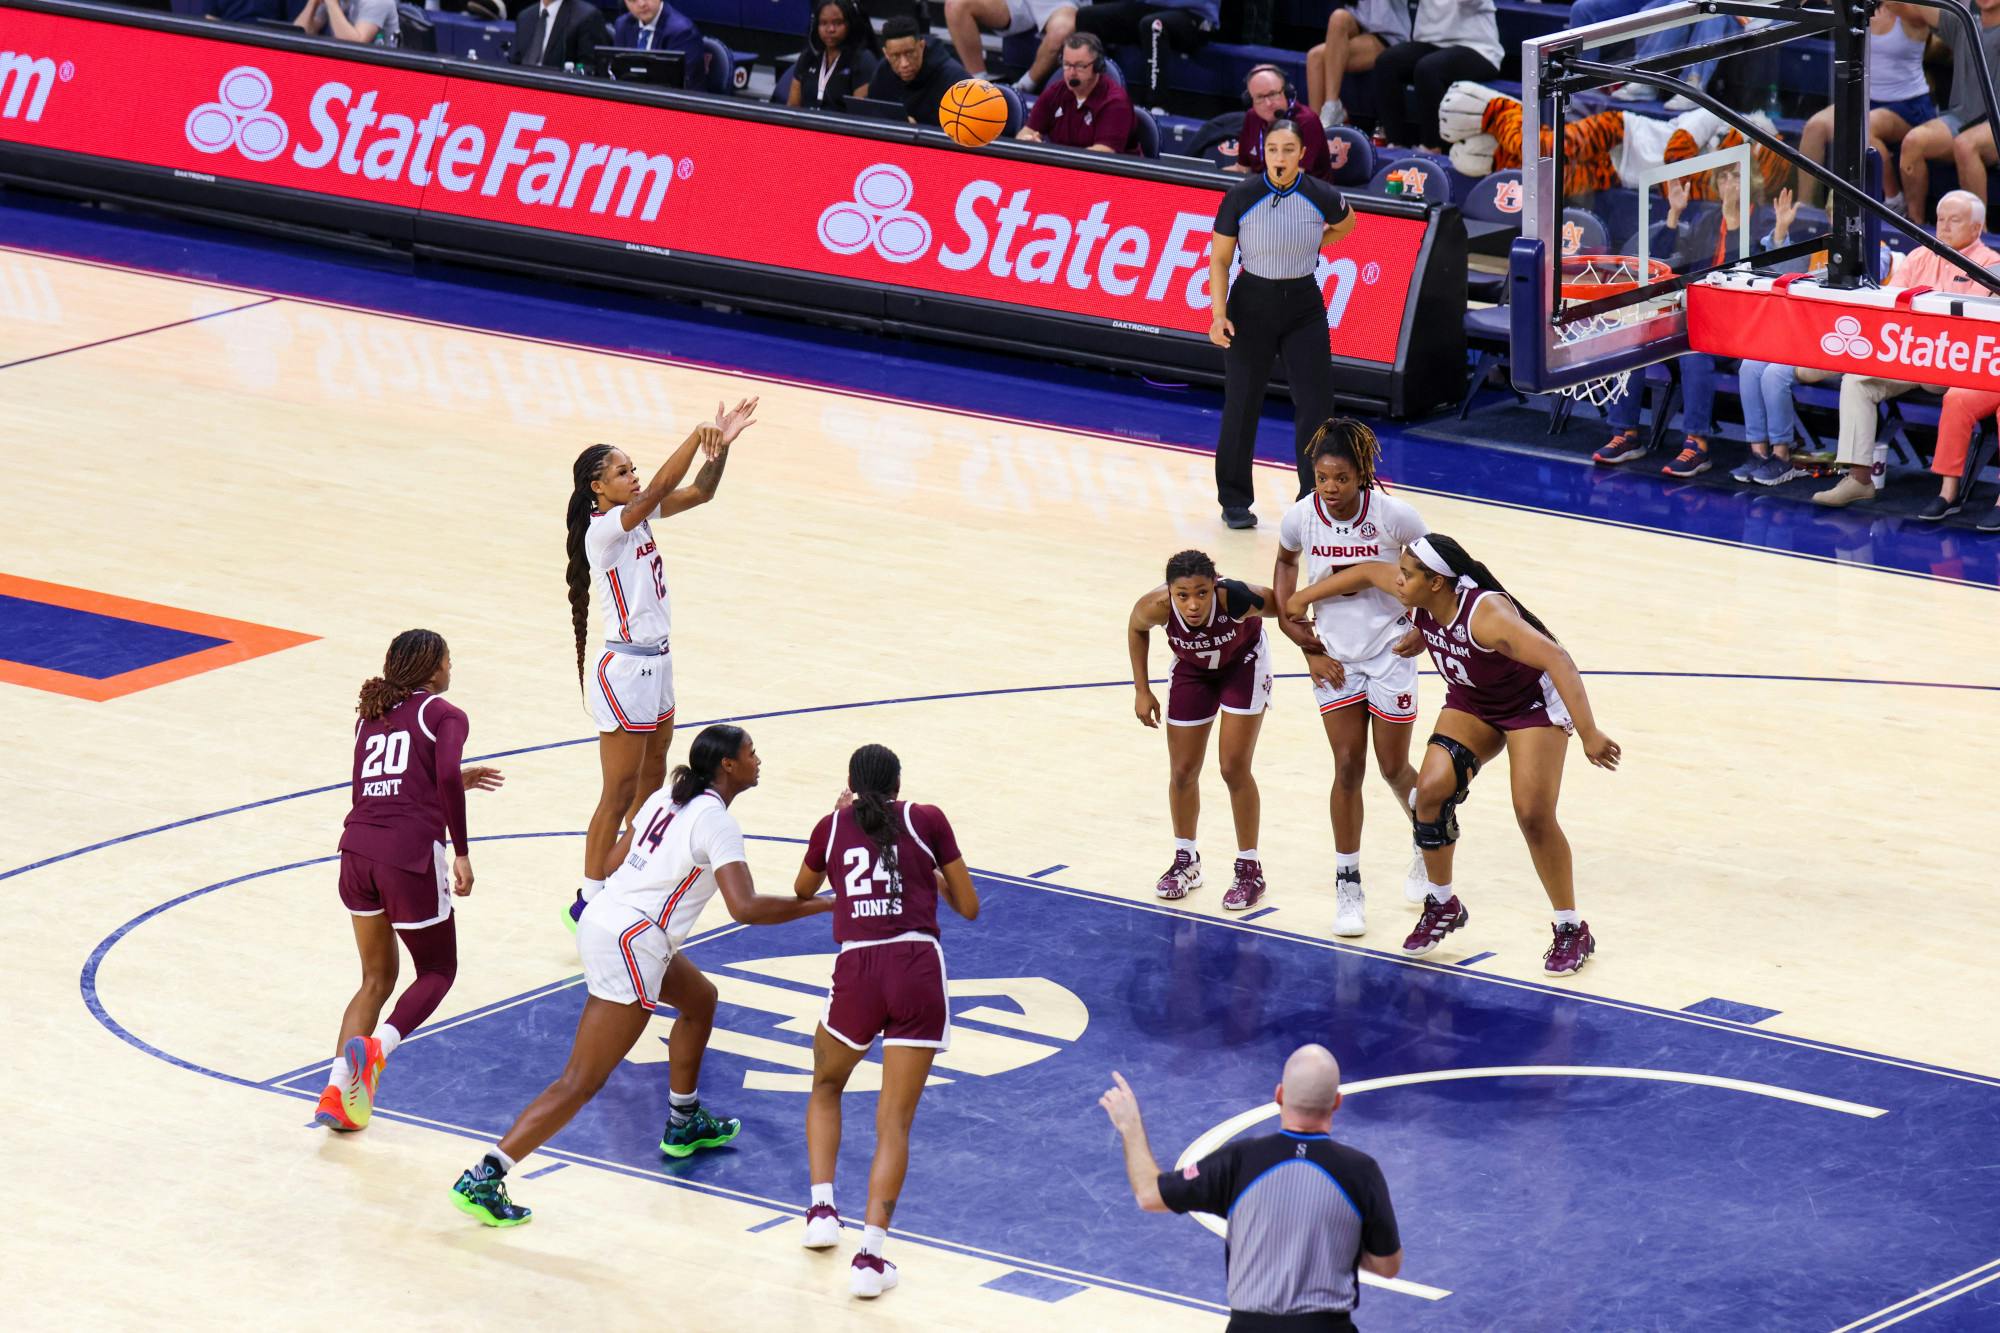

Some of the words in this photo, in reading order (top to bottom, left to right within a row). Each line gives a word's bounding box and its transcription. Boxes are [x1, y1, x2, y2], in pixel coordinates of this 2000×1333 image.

[1112, 320, 1160, 334] DAKTRONICS
[1311, 544, 1379, 558] AUBURN
[650, 554, 667, 600] 12
[1170, 636, 1211, 650] TEXAS
[1213, 628, 1237, 646] A&M
[1422, 628, 1450, 651] TEXAS
[1450, 643, 1472, 659] A&M
[1195, 649, 1221, 670] 7
[1432, 651, 1477, 688] 13
[360, 730, 411, 779] 20
[362, 778, 402, 796] KENT
[637, 806, 676, 855] 14
[843, 844, 903, 897] 24
[851, 898, 903, 919] JONES
